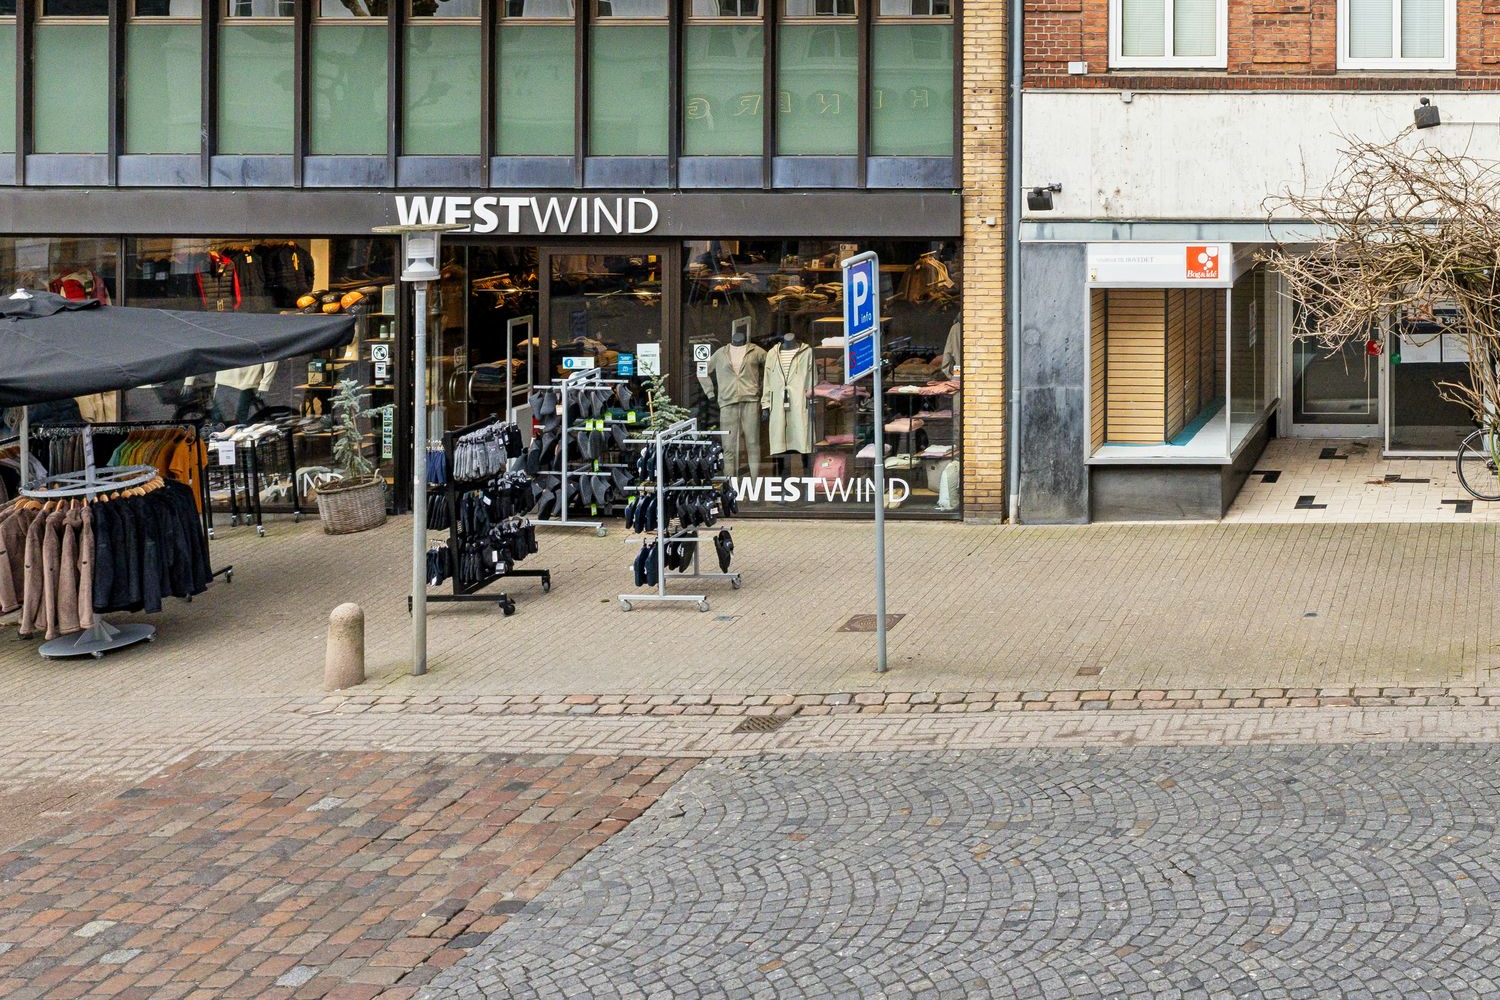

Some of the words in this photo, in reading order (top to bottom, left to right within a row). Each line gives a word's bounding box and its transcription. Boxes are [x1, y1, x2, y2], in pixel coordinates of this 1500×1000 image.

[395, 194, 660, 235] WESTWIND
[853, 271, 868, 327] P
[861, 312, 872, 323] info
[731, 476, 910, 502] WESTWIND
